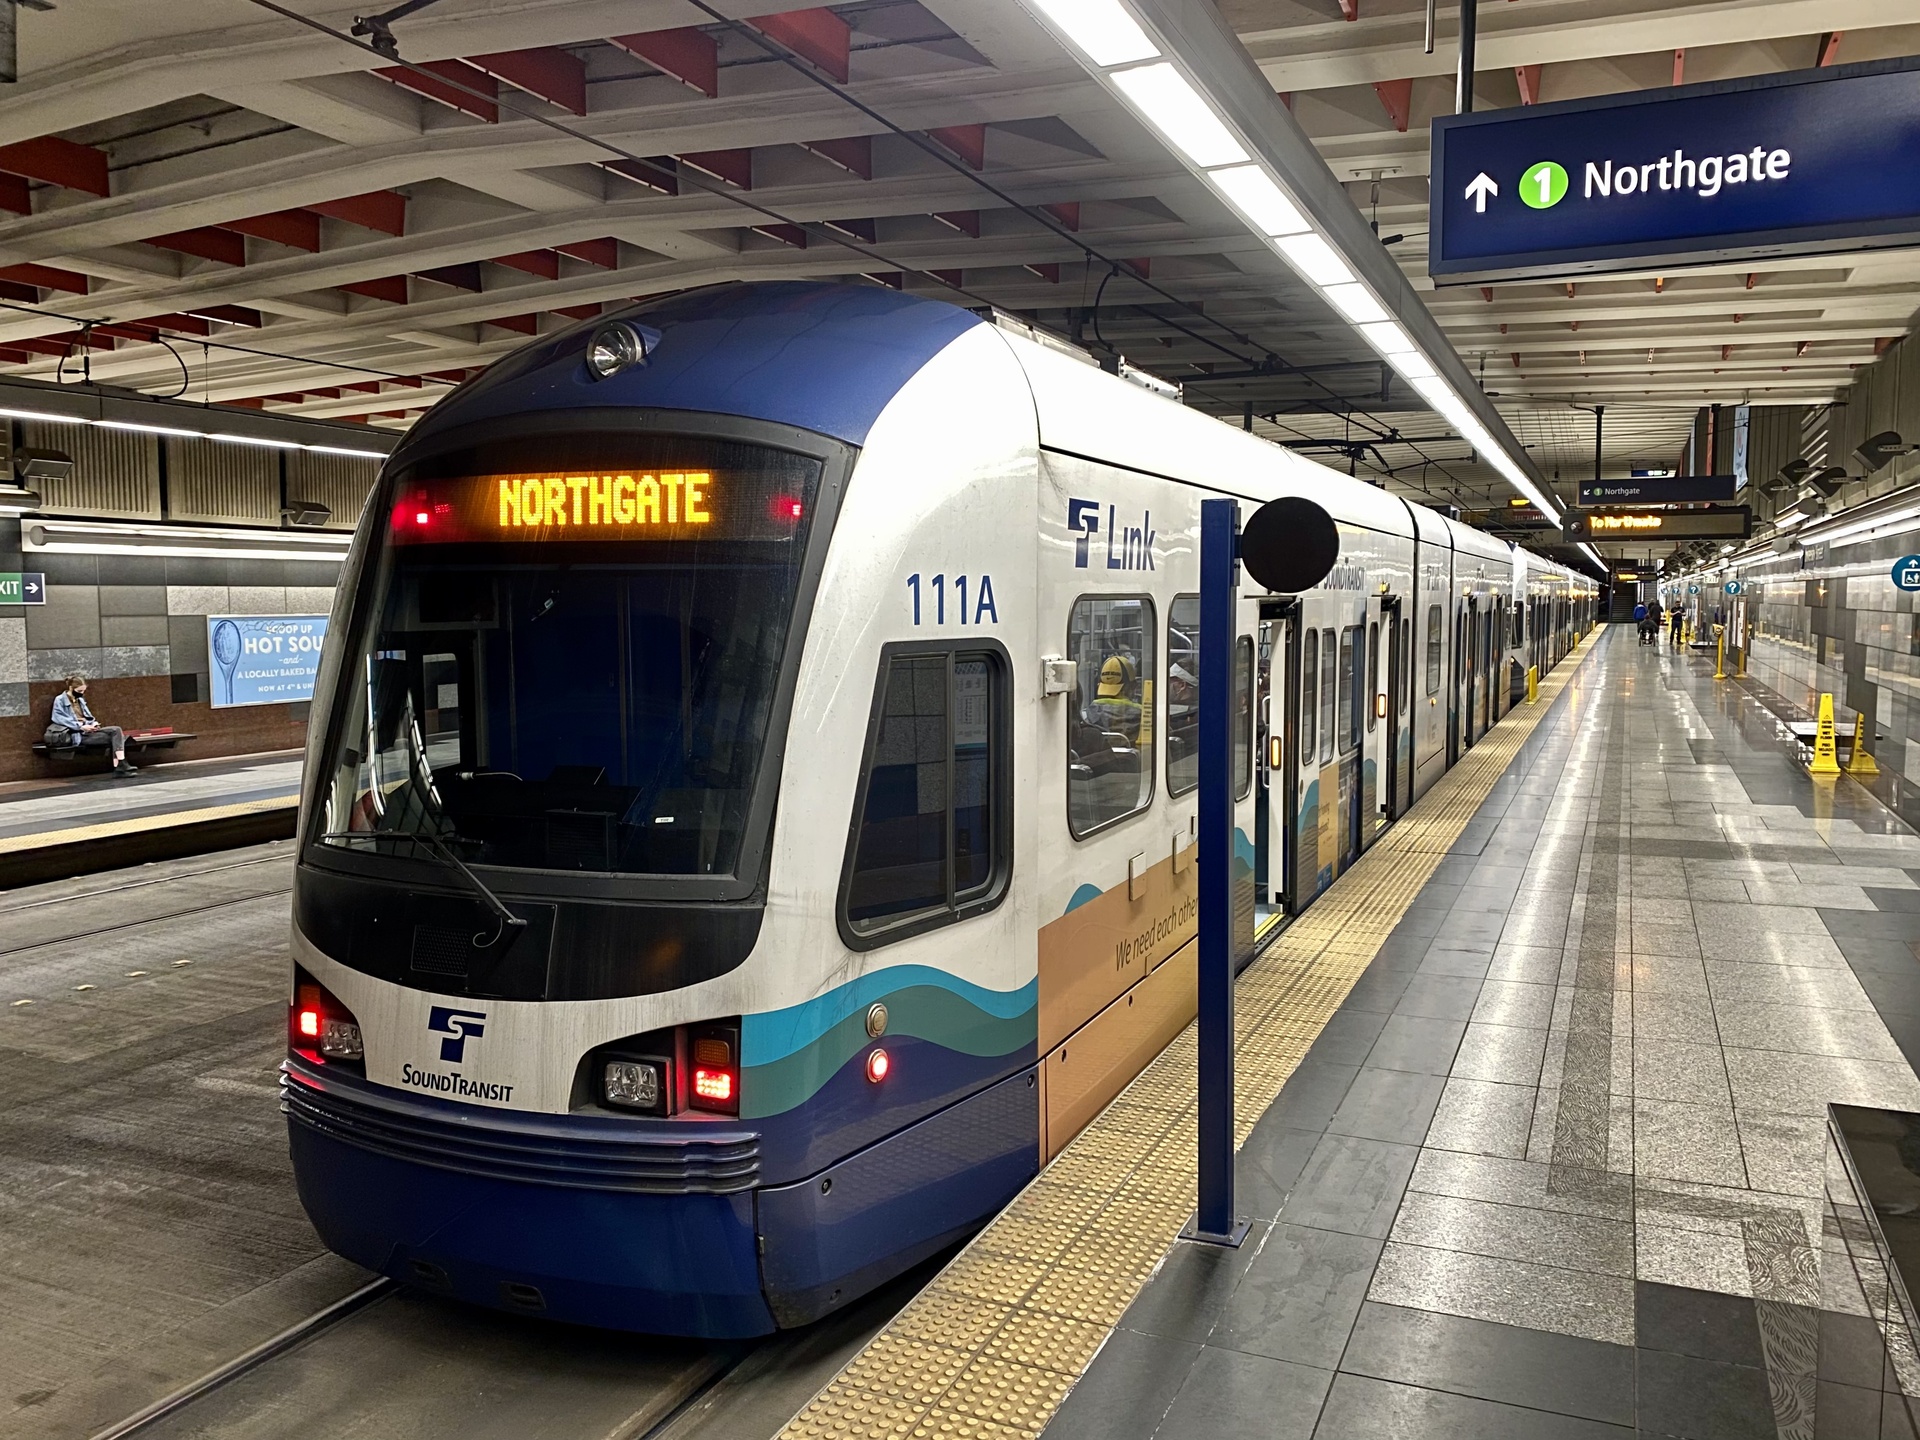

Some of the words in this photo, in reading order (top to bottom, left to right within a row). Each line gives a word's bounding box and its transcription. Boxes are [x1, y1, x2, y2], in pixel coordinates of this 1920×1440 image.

[1584, 145, 1792, 198] Northgate
[499, 472, 710, 527] NORTHGATE
[1605, 487, 1641, 496] Northgate
[1106, 504, 1156, 571] Link
[906, 573, 999, 626] 111A
[244, 636, 283, 655] HOT
[266, 625, 299, 635] SCOOP
[300, 624, 313, 634] UP
[237, 671, 244, 679] A
[244, 669, 279, 679] LOCALLY
[280, 667, 306, 677] BAKED
[1115, 938, 1132, 972] We
[1132, 918, 1156, 960] need
[1156, 905, 1177, 942] each
